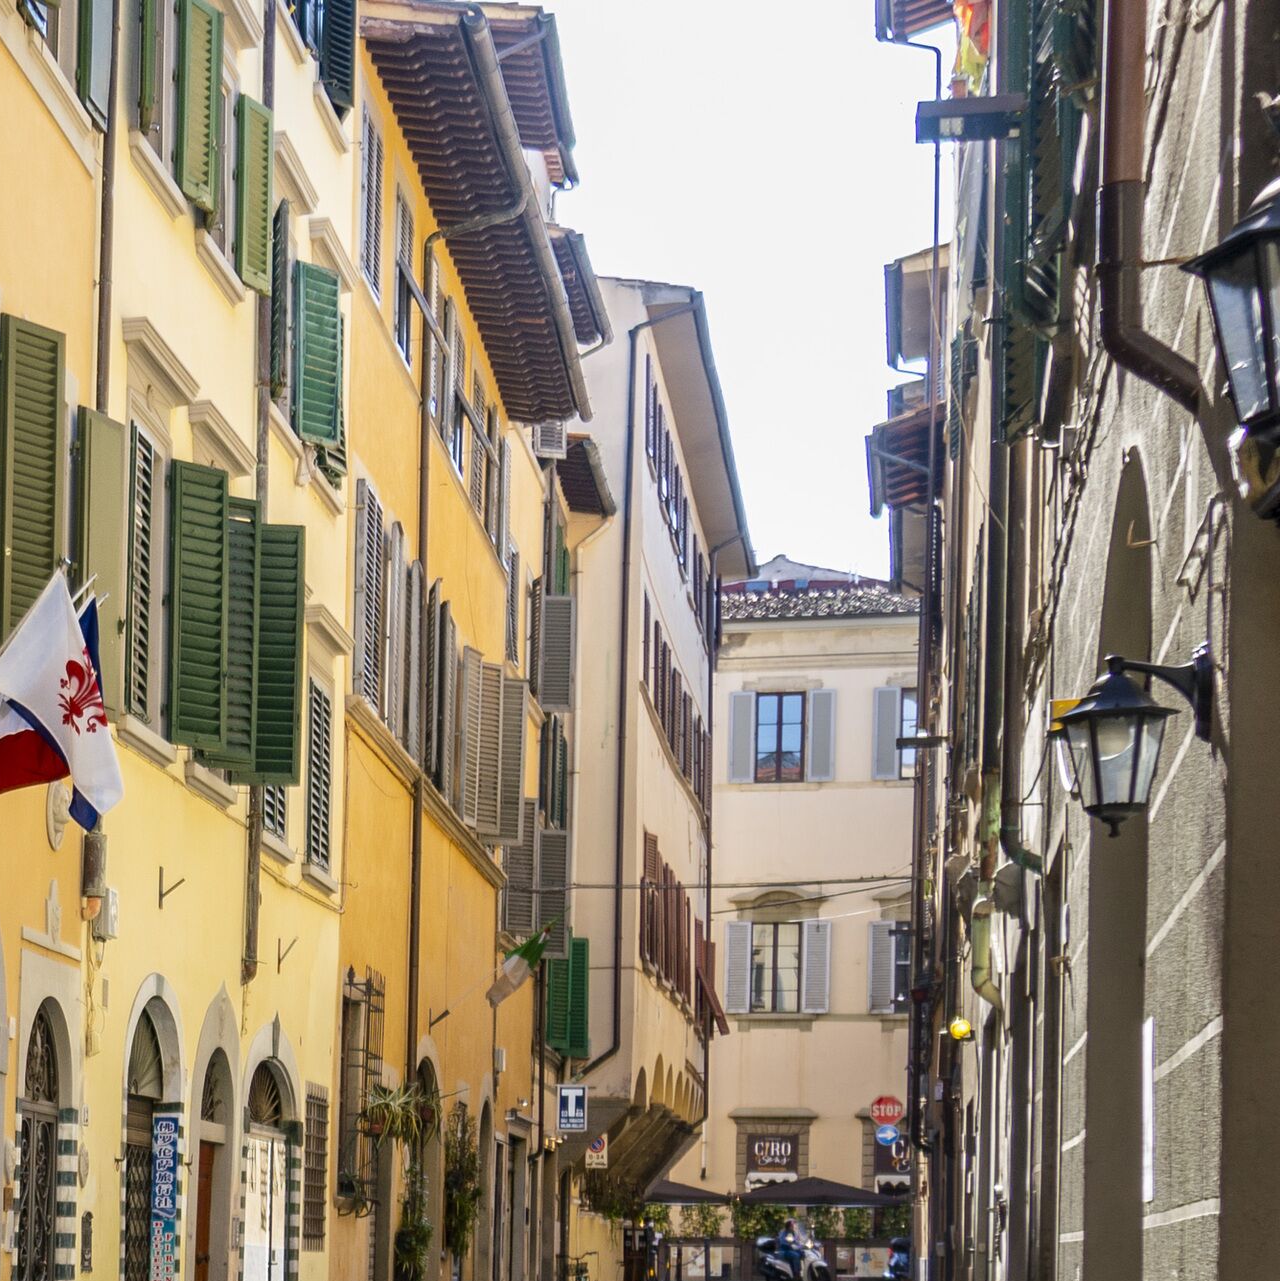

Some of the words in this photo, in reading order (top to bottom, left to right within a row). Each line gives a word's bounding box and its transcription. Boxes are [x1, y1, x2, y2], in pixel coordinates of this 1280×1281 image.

[561, 1088, 584, 1117] T
[872, 1104, 902, 1117] STOP
[754, 1141, 791, 1156] CIRO
